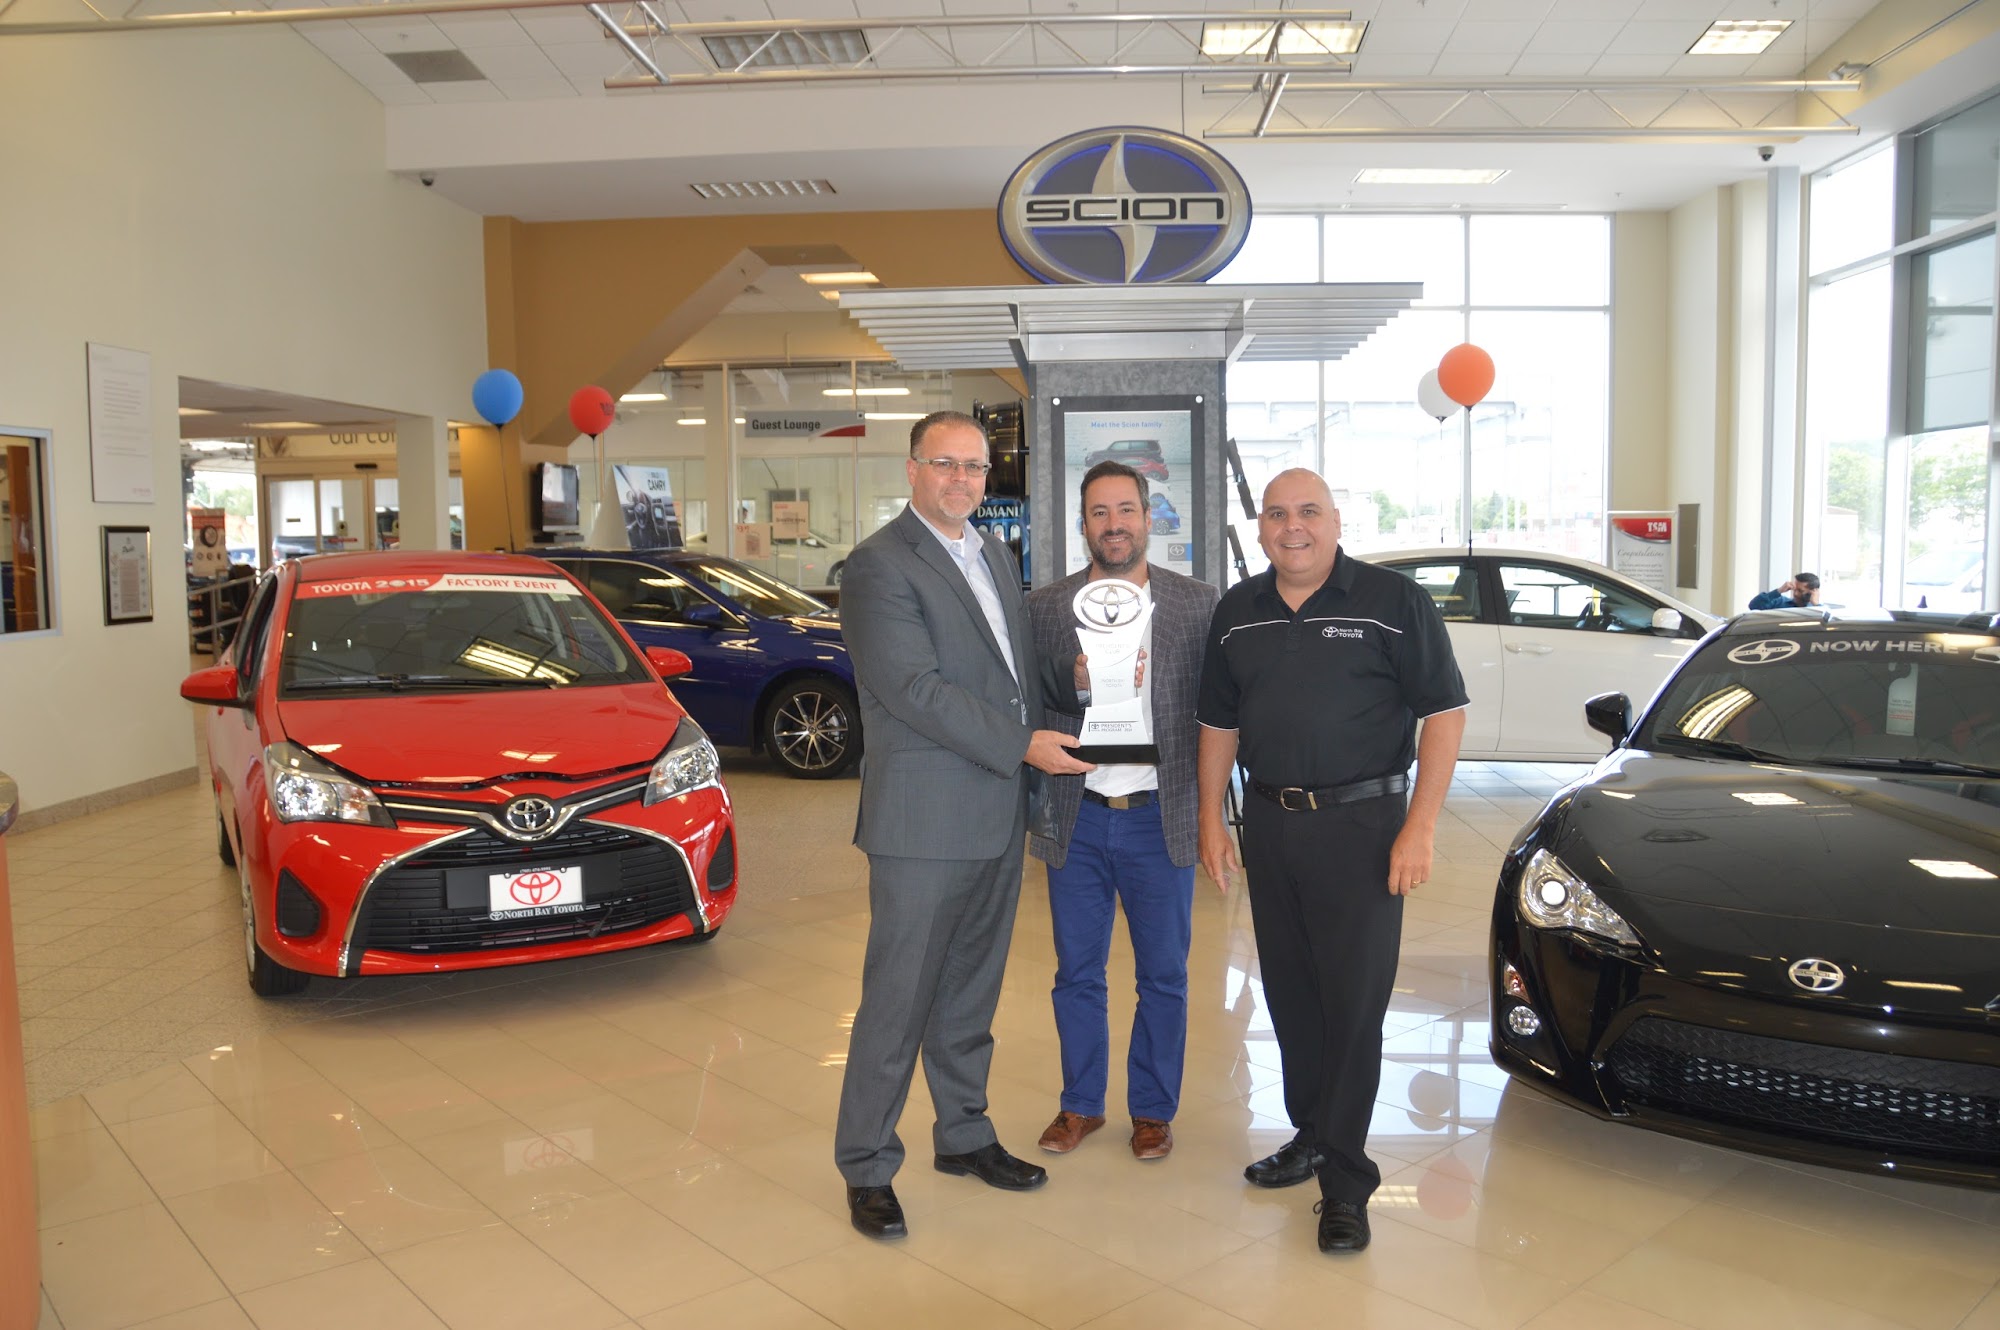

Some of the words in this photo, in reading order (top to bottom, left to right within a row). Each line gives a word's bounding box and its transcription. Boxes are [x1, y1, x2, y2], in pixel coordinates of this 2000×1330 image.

[752, 419, 782, 430] Guest
[784, 419, 821, 431] Lounge
[1141, 421, 1162, 429] family
[977, 505, 1019, 518] DASANI
[312, 581, 372, 594] TOYOTA
[446, 578, 510, 588] FACTORY
[514, 581, 557, 590] EVENT
[1809, 640, 1879, 653] NOW
[1885, 640, 1959, 654] HERE
[504, 909, 534, 919] NORTH
[534, 907, 551, 916] BAY
[551, 904, 584, 914] TOYOTA
